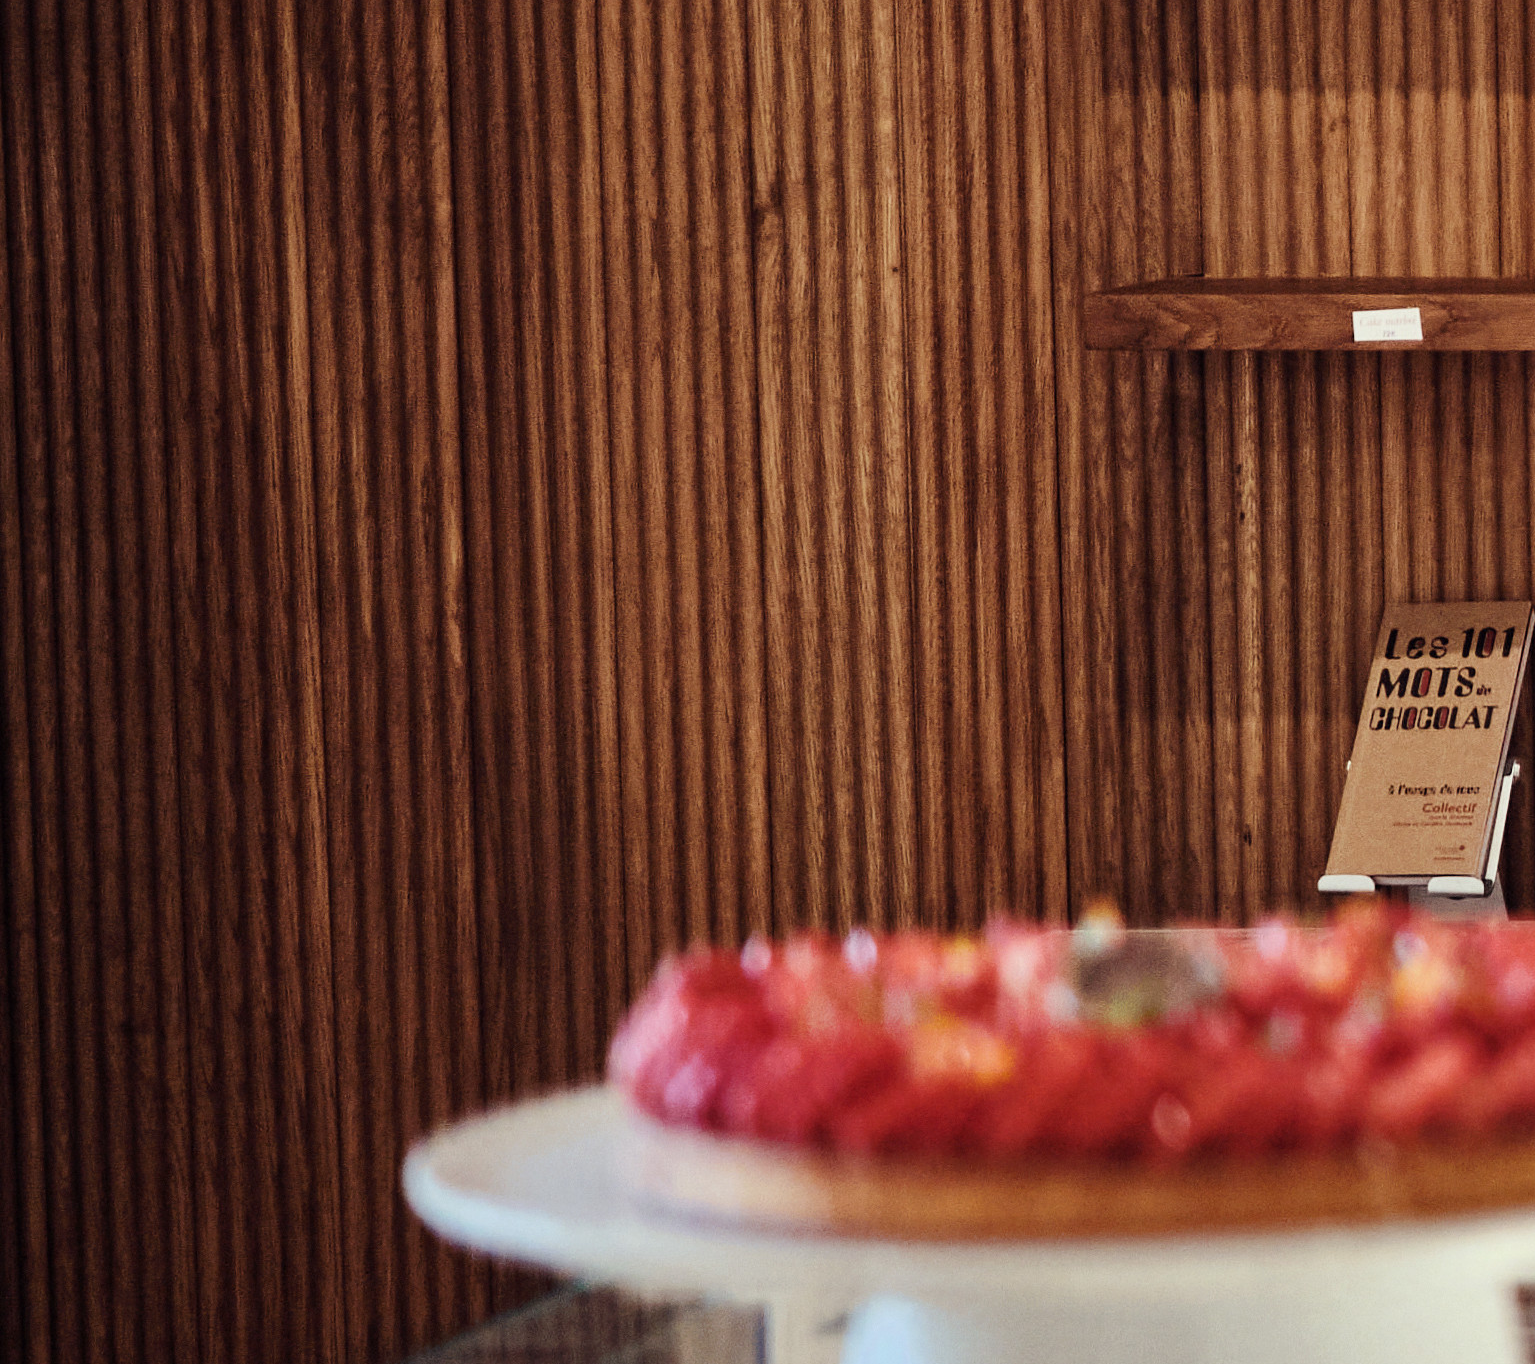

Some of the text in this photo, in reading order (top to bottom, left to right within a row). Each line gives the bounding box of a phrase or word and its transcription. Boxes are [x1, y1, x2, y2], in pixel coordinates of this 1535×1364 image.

[1384, 626, 1517, 660] Les 101
[1376, 666, 1477, 698] MOTS
[1369, 705, 1499, 731] CHOCOLAT
[1422, 802, 1478, 813] Collectif
